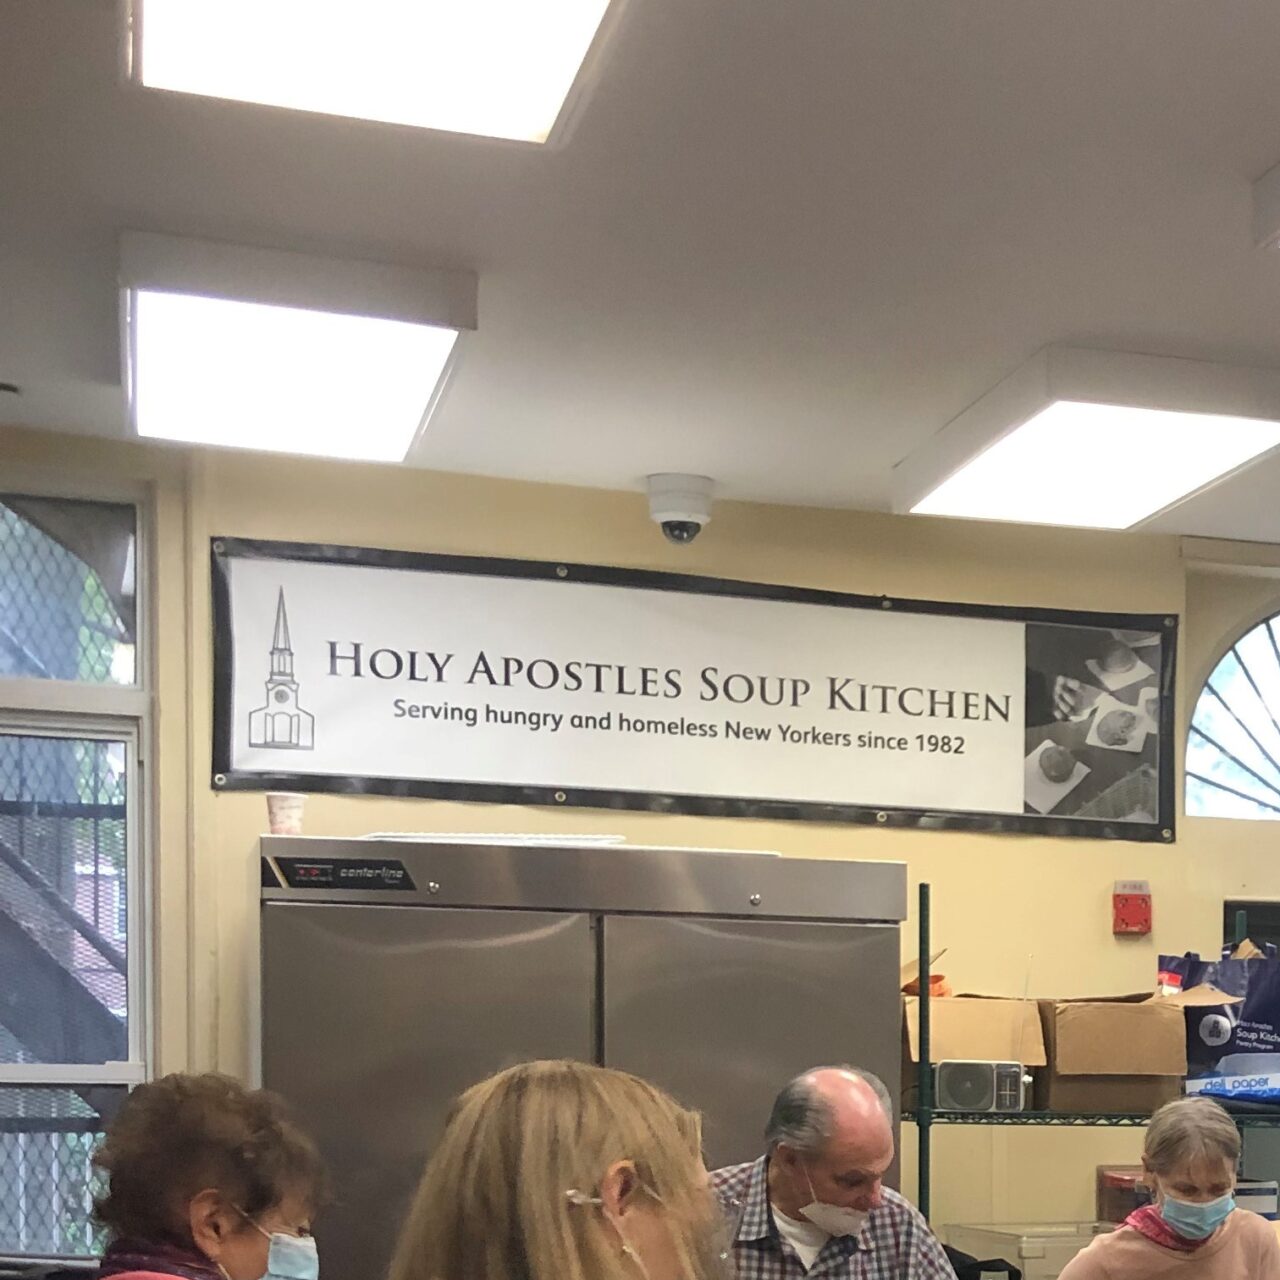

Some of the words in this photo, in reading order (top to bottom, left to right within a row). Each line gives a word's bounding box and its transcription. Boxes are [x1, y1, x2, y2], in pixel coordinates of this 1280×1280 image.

[327, 639, 453, 684] HOLY
[468, 650, 682, 700] APOSTLES
[699, 666, 810, 707] SOUP
[827, 676, 1012, 723] KITCHEN
[393, 700, 478, 727] Serving
[485, 705, 563, 732] hungry
[570, 711, 612, 731] and
[618, 713, 718, 738] homeless
[725, 720, 770, 741] New
[778, 723, 851, 747] Yorkers
[857, 731, 908, 751] since
[915, 734, 965, 755] 1982
[340, 866, 404, 879] centerline
[1236, 1028, 1258, 1040] Soup
[1233, 1075, 1269, 1090] paper
